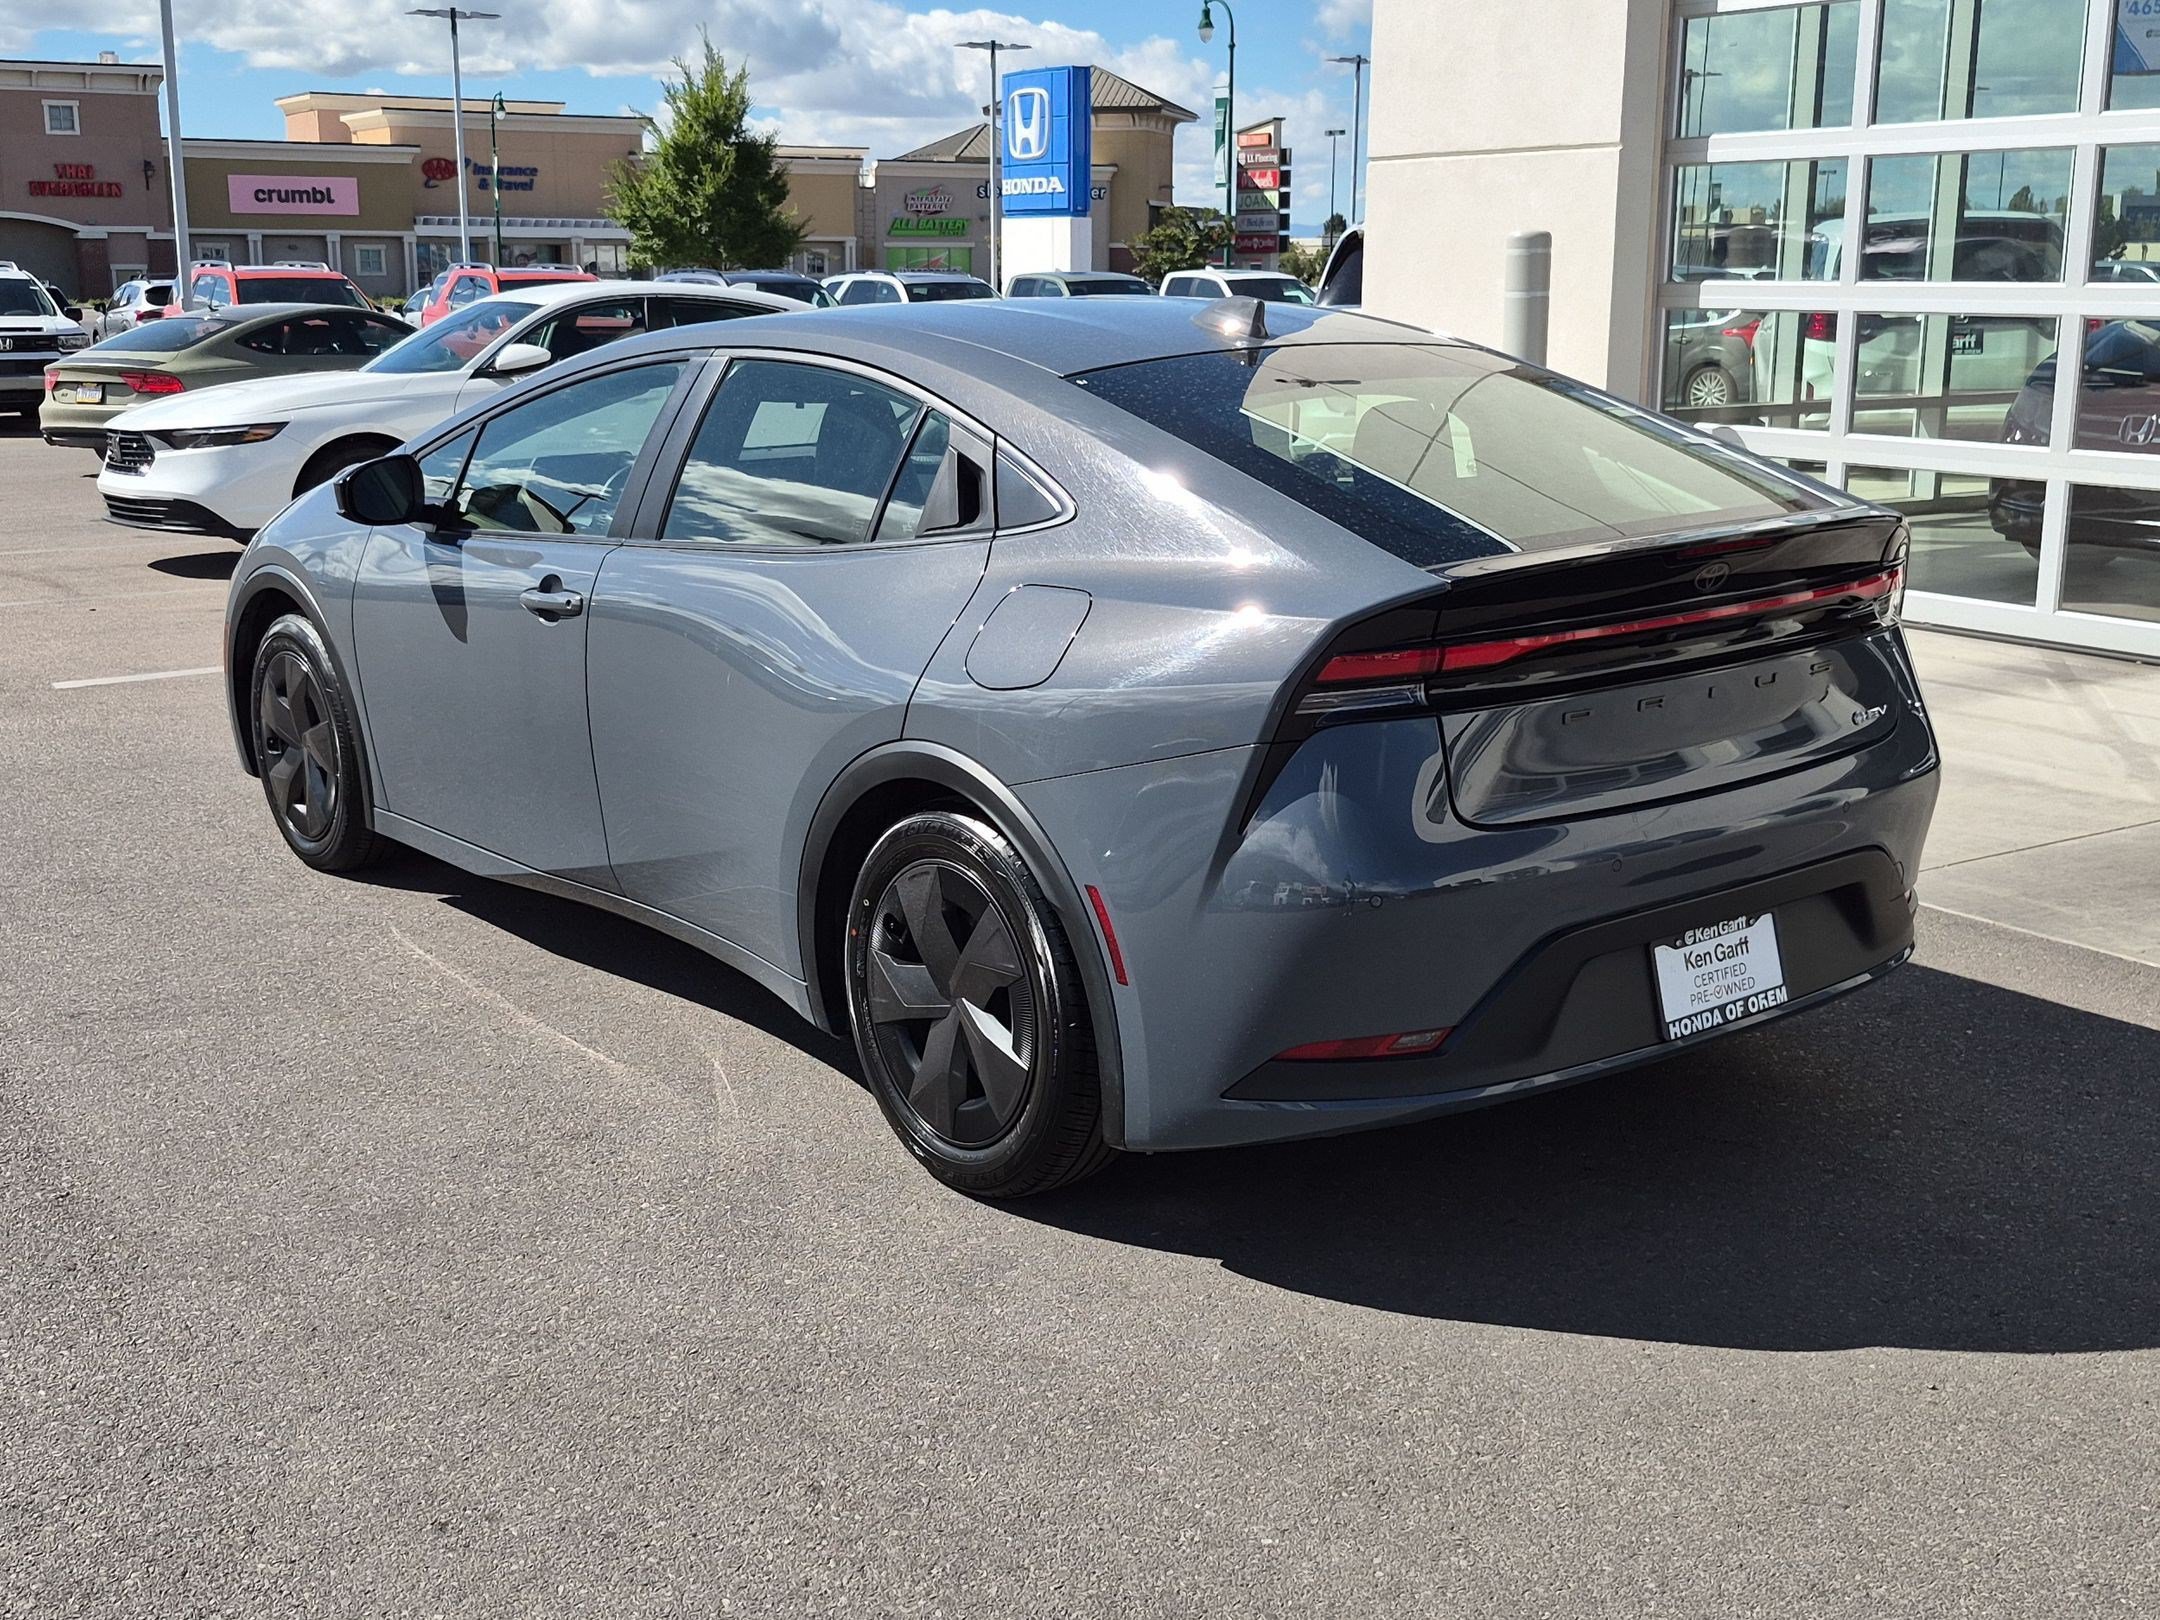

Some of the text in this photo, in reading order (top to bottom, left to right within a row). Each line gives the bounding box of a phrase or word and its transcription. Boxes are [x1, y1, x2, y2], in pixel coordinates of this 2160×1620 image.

[54, 164, 94, 179] THAI
[253, 187, 336, 204] crumbl
[1002, 176, 1065, 195] HONDA
[1238, 192, 1277, 208] JOANN
[891, 218, 969, 230] ALL BATTERY
[1562, 660, 1832, 725] PRIUS
[1695, 915, 1747, 942] Ken Garff
[1683, 935, 1750, 972] Ken Garff
[1693, 962, 1747, 988] CERTIFIED
[1668, 985, 1789, 1040] HONDA OF OREM
